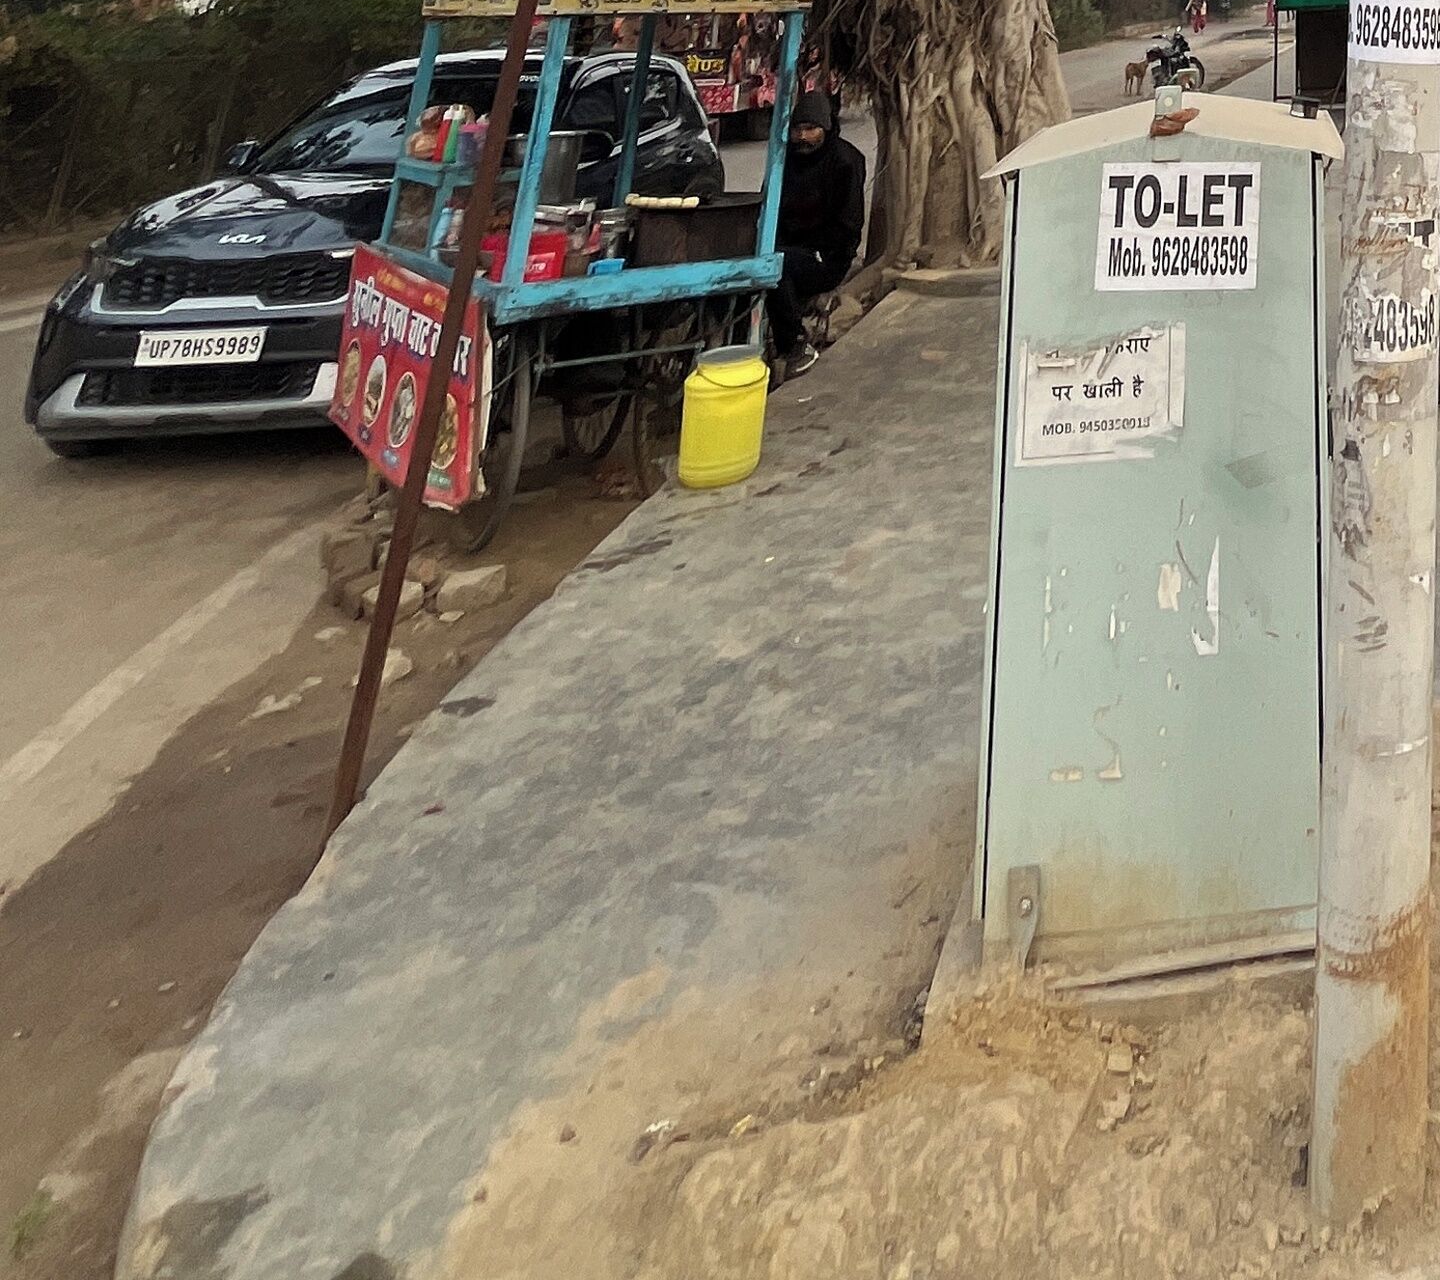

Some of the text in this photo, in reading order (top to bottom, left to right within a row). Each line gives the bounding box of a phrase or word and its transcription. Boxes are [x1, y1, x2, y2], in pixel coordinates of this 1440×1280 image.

[1108, 173, 1253, 229] TO-LET
[1107, 236, 1249, 278] Mob. 9628483598
[149, 335, 261, 359] UP78HS9989
[1052, 374, 1145, 401] पर खाली है
[1042, 422, 1076, 437] MOB.
